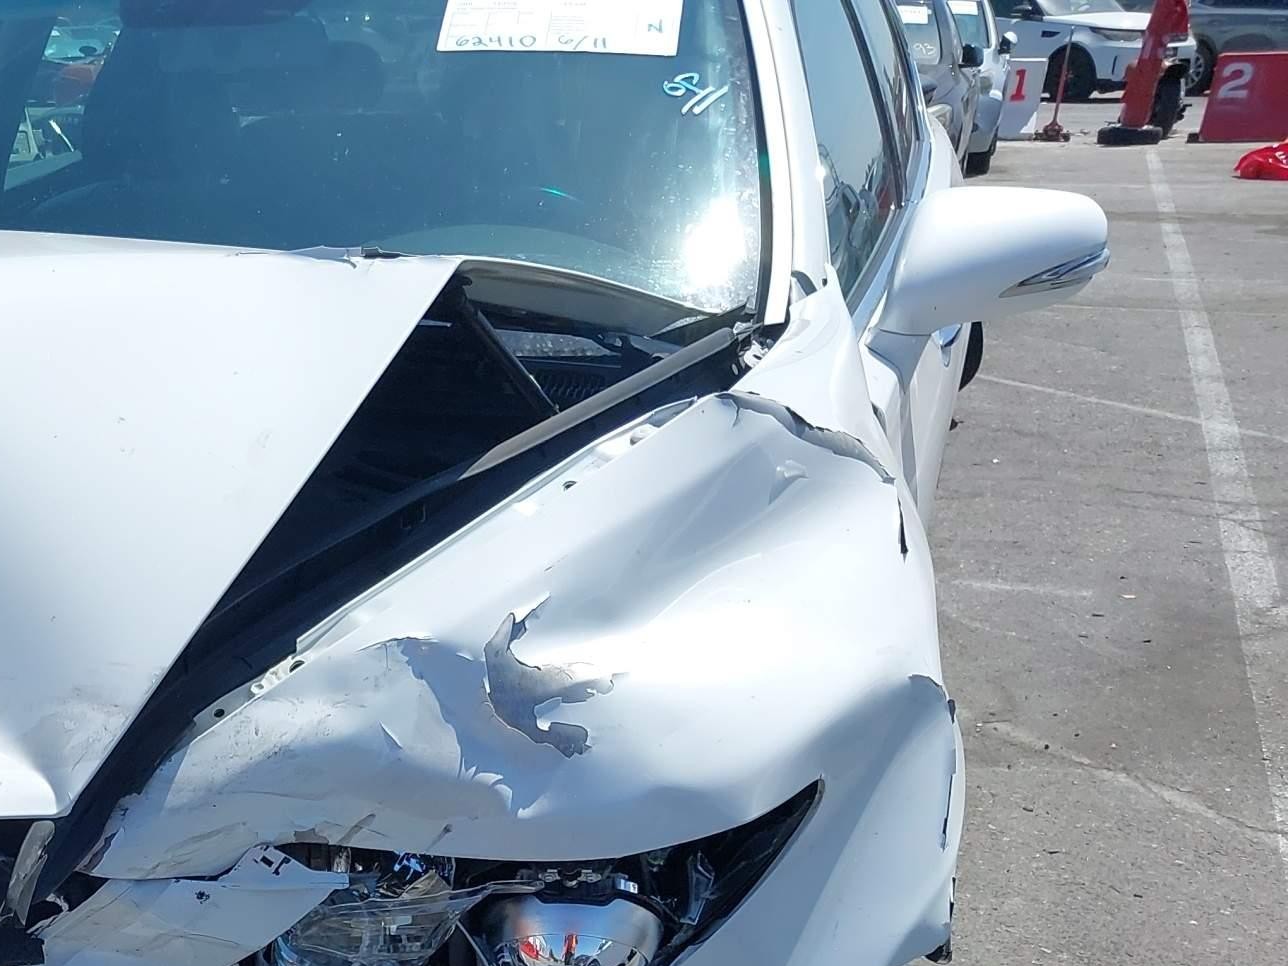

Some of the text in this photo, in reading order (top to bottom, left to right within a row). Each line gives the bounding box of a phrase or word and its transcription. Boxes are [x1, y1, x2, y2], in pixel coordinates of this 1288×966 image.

[455, 35, 537, 48] 62410
[1009, 69, 1026, 101] 1
[1218, 62, 1253, 98] 2
